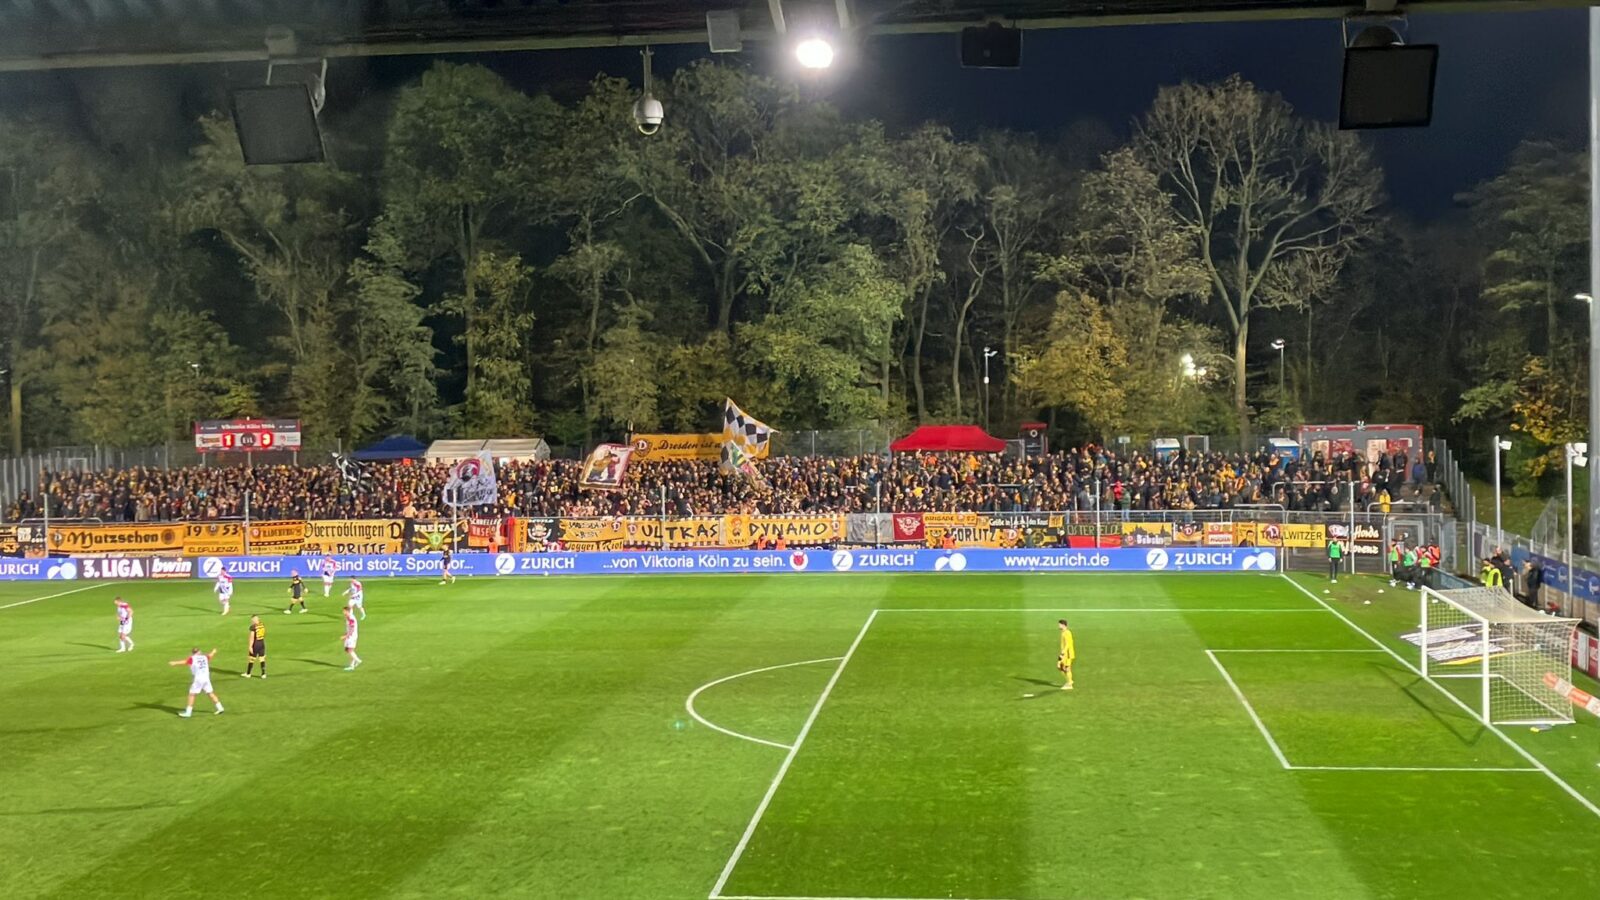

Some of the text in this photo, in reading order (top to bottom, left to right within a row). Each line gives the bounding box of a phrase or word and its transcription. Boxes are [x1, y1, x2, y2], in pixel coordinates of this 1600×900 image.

[225, 434, 233, 446] 1
[262, 433, 271, 446] 3
[187, 524, 239, 536] 19 53
[749, 522, 828, 537] DYNAMO
[152, 557, 192, 573] bwin
[336, 558, 362, 571] sind
[367, 558, 402, 573] stolz,
[406, 557, 474, 572] Sponor...
[521, 557, 574, 569] ZURICH
[641, 555, 694, 568] Viktoria
[698, 554, 728, 568] Köln
[733, 558, 749, 568] zu
[753, 555, 786, 567] sein.
[859, 554, 914, 566] ZURICH
[1004, 553, 1109, 567] www.zurich.de
[1175, 553, 1232, 566] ZURICH
[0, 564, 39, 575] URICH
[83, 560, 144, 577] 3. LIGA
[228, 561, 280, 573] ZURICH
